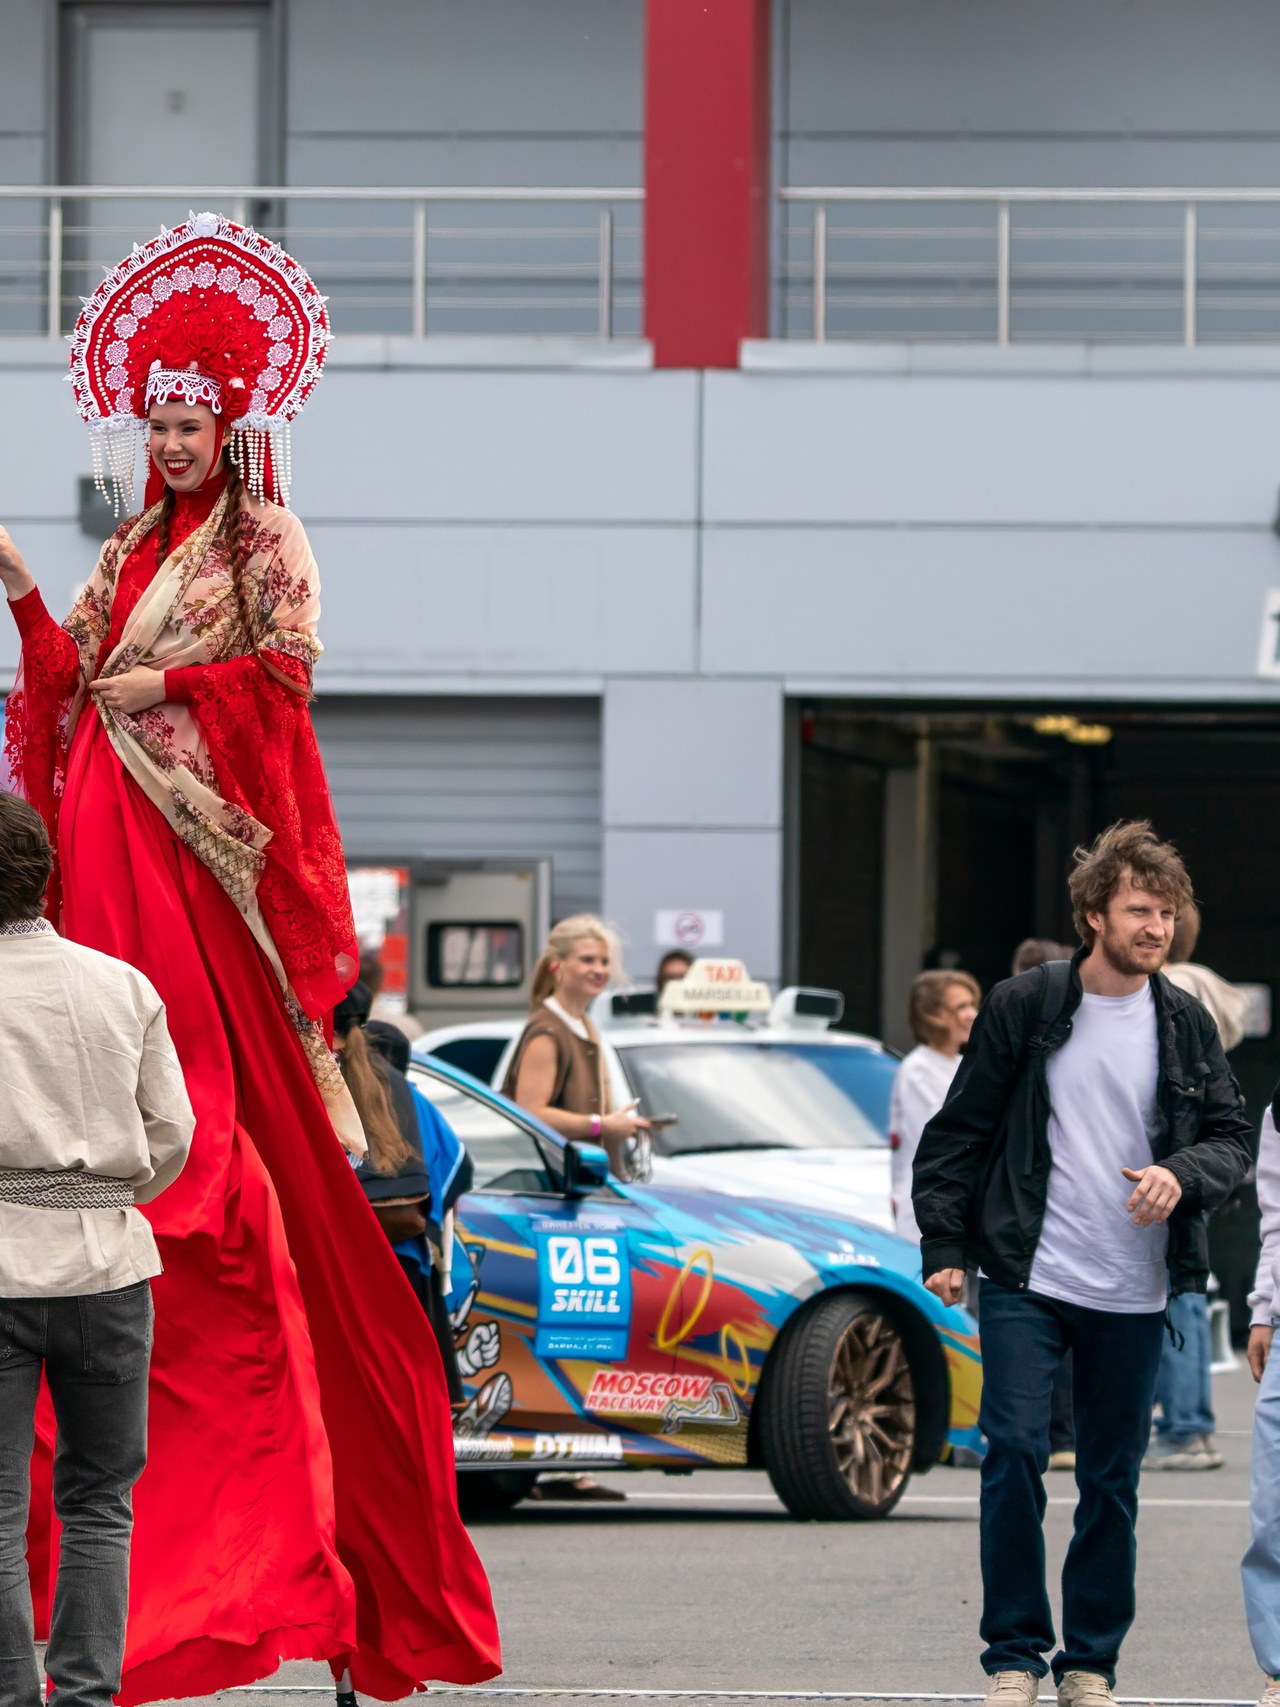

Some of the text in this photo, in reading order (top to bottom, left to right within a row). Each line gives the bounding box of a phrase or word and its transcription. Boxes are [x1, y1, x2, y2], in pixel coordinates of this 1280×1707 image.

[705, 965, 743, 982] TAXI
[547, 1236, 621, 1285] 06
[551, 1289, 620, 1312] SKILL
[591, 1372, 711, 1399] MOSCOW
[586, 1395, 666, 1412] RACEWAY
